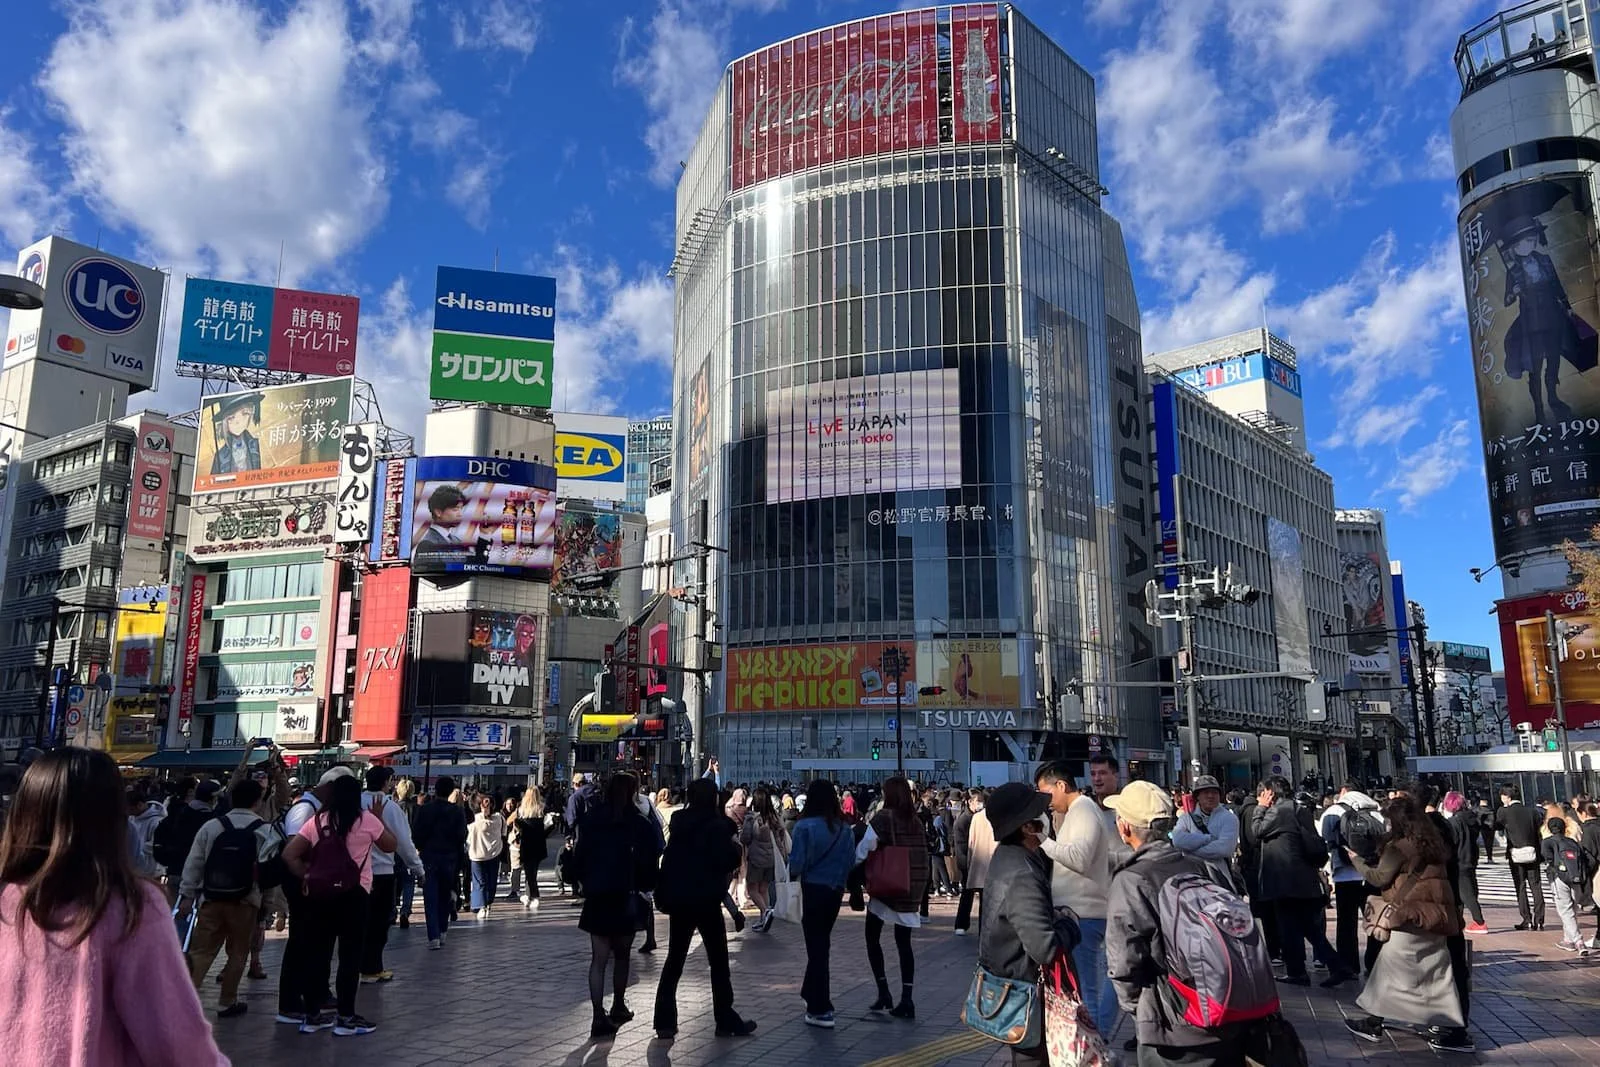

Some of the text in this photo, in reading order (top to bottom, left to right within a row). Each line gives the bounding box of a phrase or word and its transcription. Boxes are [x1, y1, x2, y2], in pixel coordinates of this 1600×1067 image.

[202, 296, 257, 322] 龍角散
[437, 291, 554, 318] Hisamitsu
[193, 318, 264, 344] ダイレクト
[291, 307, 343, 331] 龍角散
[283, 328, 349, 353] ダイレクト
[110, 351, 144, 372] VISA
[439, 351, 545, 386] サロンパス
[1184, 359, 1252, 389] SEIBU
[1269, 363, 1300, 394] SEIBU
[268, 418, 342, 447] 雨が来る
[808, 412, 907, 437] LVE JAPAN
[860, 433, 894, 445] TOKYO
[466, 459, 511, 478] DHC
[555, 446, 615, 467] EA
[336, 425, 374, 538] もんじゃ
[1115, 364, 1153, 663] TSUTAYA
[463, 564, 481, 572] DHC
[472, 662, 530, 687] DMM
[734, 646, 858, 680] VAUNDY
[487, 684, 516, 705] TV
[734, 678, 857, 710] replica
[920, 709, 1017, 728] TSUTAYA
[419, 722, 512, 744] 大盛堂書
[872, 740, 917, 750] SHIBYA
